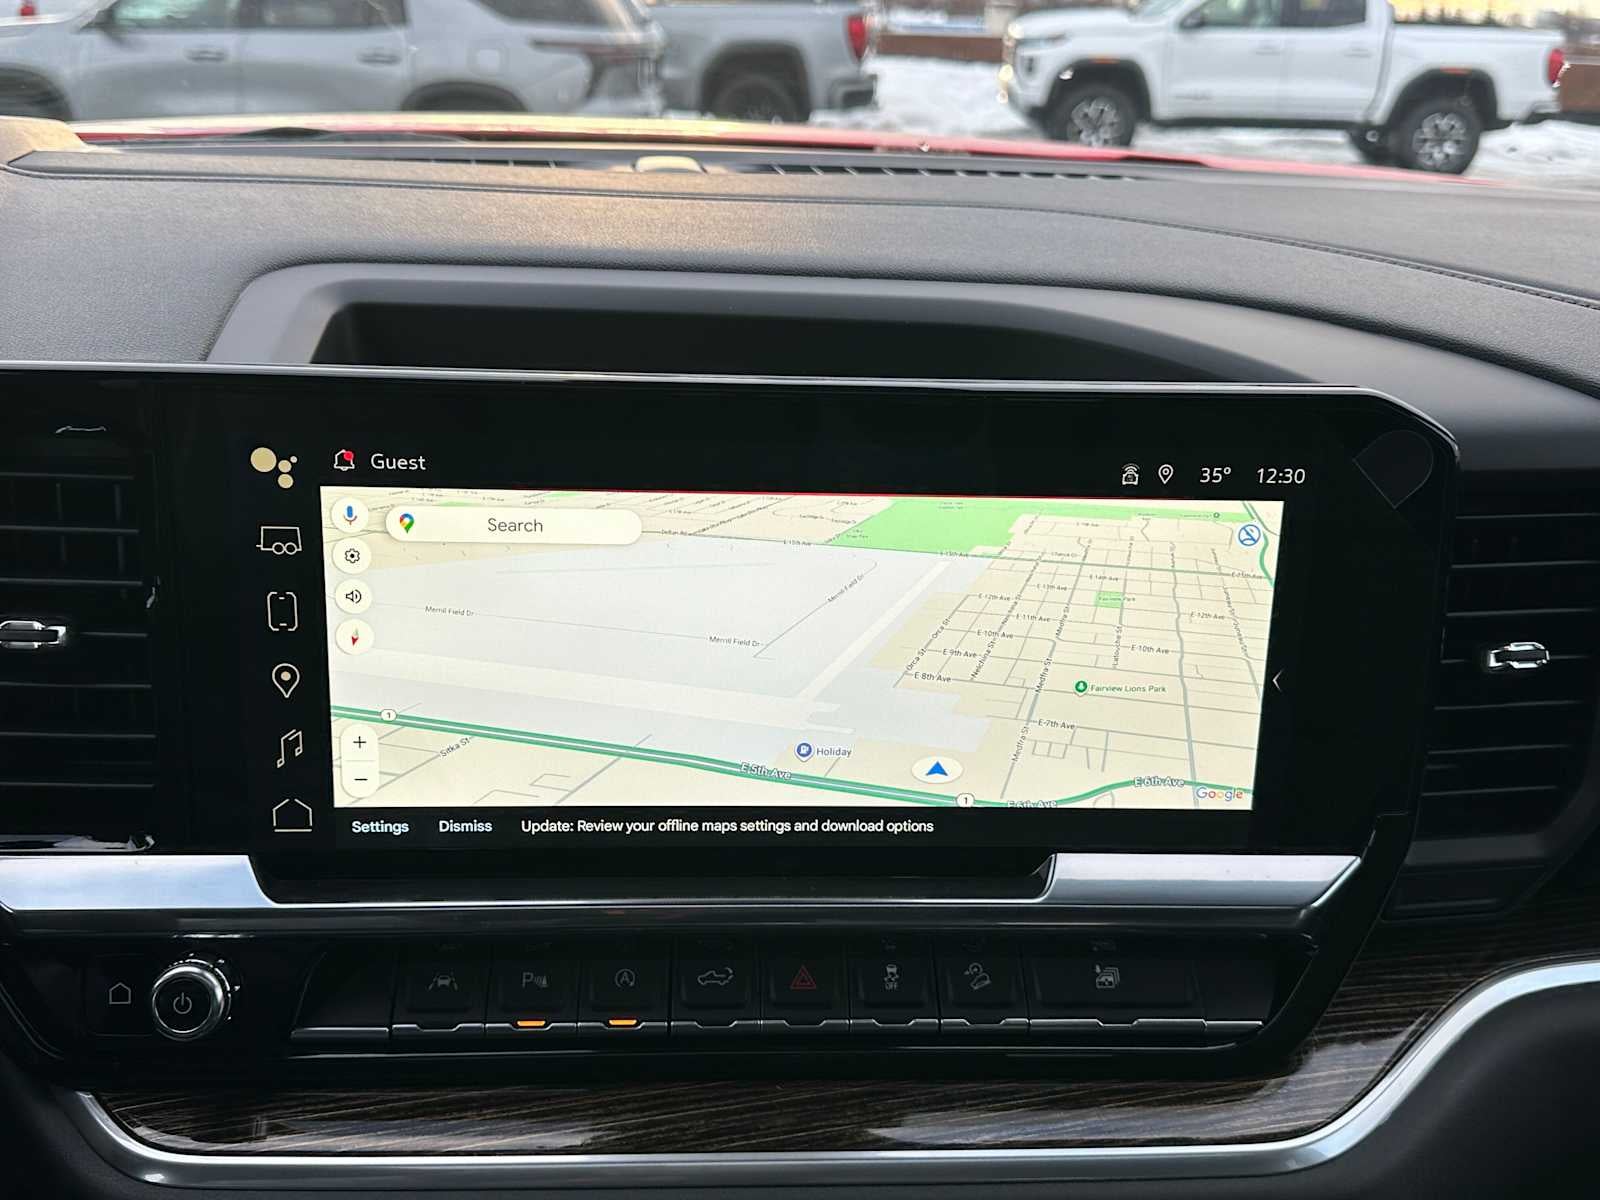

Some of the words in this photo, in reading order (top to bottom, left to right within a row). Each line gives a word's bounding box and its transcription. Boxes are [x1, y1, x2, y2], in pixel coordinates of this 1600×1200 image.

[370, 453, 427, 471] Guest
[1199, 466, 1232, 483] 35°
[1256, 468, 1306, 484] 12:30
[487, 517, 544, 534] Search
[985, 593, 999, 601] 12th
[424, 604, 447, 614] Merrill
[447, 606, 464, 615] Field
[465, 608, 475, 617] Dr
[931, 625, 945, 640] Orca
[984, 630, 1000, 638] 10th
[1000, 631, 1014, 639] Ave
[708, 635, 732, 645] Merrill
[732, 637, 751, 646] Field
[751, 639, 761, 648] Dr
[942, 648, 948, 656] E
[948, 649, 960, 658] 9th
[961, 650, 978, 659] Ave
[1138, 645, 1155, 653] 10th
[1156, 646, 1170, 654] Ave
[905, 655, 920, 671] Orca
[914, 671, 920, 679] E
[921, 672, 936, 681] 8th
[936, 673, 952, 682] Ave
[1090, 684, 1122, 693] Fairview
[1124, 684, 1145, 693] Lions
[1147, 685, 1166, 693] Park
[1046, 719, 1059, 729] 7th
[1060, 721, 1076, 730] Ave
[439, 742, 461, 757] Sitka
[456, 736, 470, 747] St
[816, 746, 852, 759] Holiday
[740, 761, 749, 773] E
[750, 763, 769, 777] 5th
[769, 768, 792, 781] Ave
[1134, 777, 1142, 787] E
[1143, 777, 1161, 788] 6th
[1163, 777, 1185, 788] Ave
[1195, 787, 1244, 802] Google
[351, 820, 410, 836] Settings
[438, 820, 493, 833] Dismiss
[521, 820, 574, 836] Update:
[577, 820, 625, 833] Review
[626, 822, 655, 835] your
[657, 819, 699, 833] offline
[701, 823, 738, 835] maps
[740, 820, 791, 836] settings
[794, 820, 819, 833] and
[821, 819, 884, 833] download
[886, 820, 935, 836] options
[884, 982, 899, 990] OFF
